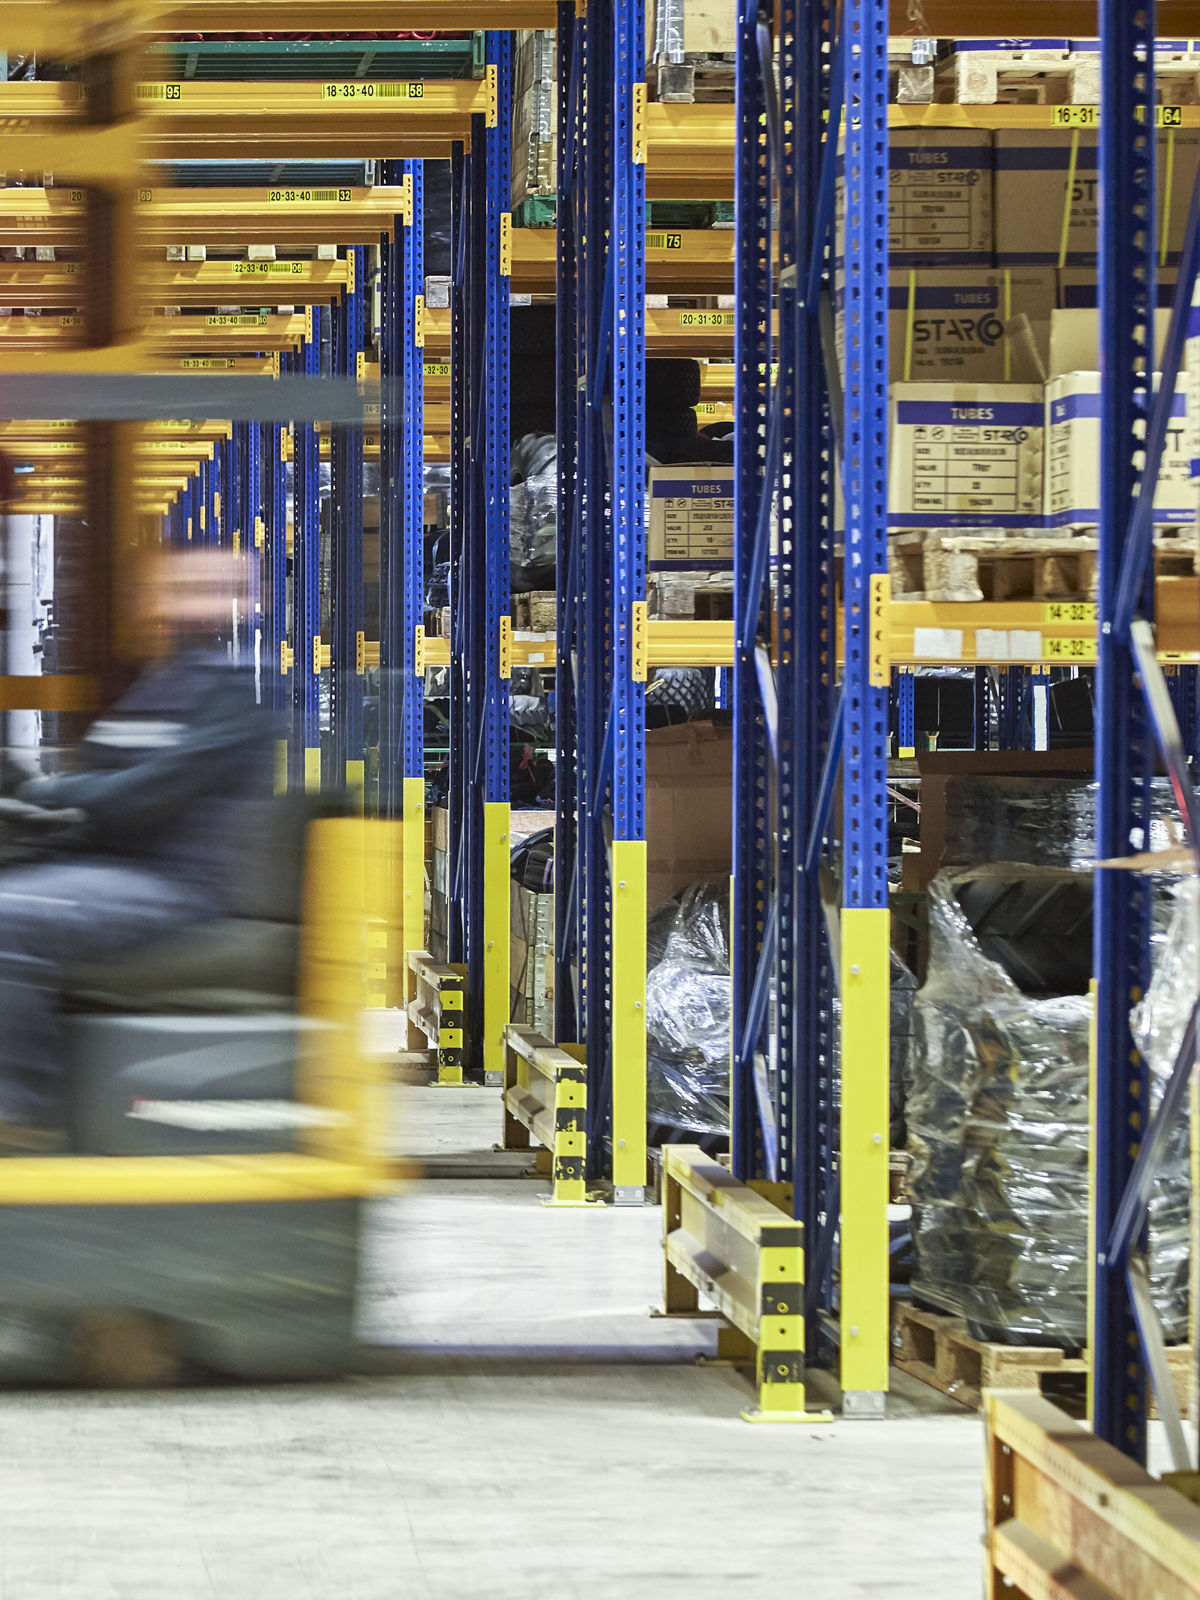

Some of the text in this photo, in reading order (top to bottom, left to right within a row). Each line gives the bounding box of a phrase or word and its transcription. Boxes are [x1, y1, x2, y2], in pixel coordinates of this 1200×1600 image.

[166, 86, 180, 98] 95
[326, 84, 423, 97] 18-33-40 58
[1163, 108, 1181, 123] 64
[908, 152, 948, 164] TUBES
[140, 191, 151, 201] 69
[271, 190, 351, 201] 20-33-40 32
[667, 235, 680, 248] 75
[234, 263, 302, 273] 22-33-40 06
[953, 293, 991, 304] TUBES
[682, 314, 722, 325] 20-31-30
[913, 312, 1003, 346] STARCO
[706, 405, 715, 413] 23
[950, 407, 994, 420] TUBES
[983, 427, 1029, 445] STARCO
[691, 484, 722, 494] TUBES
